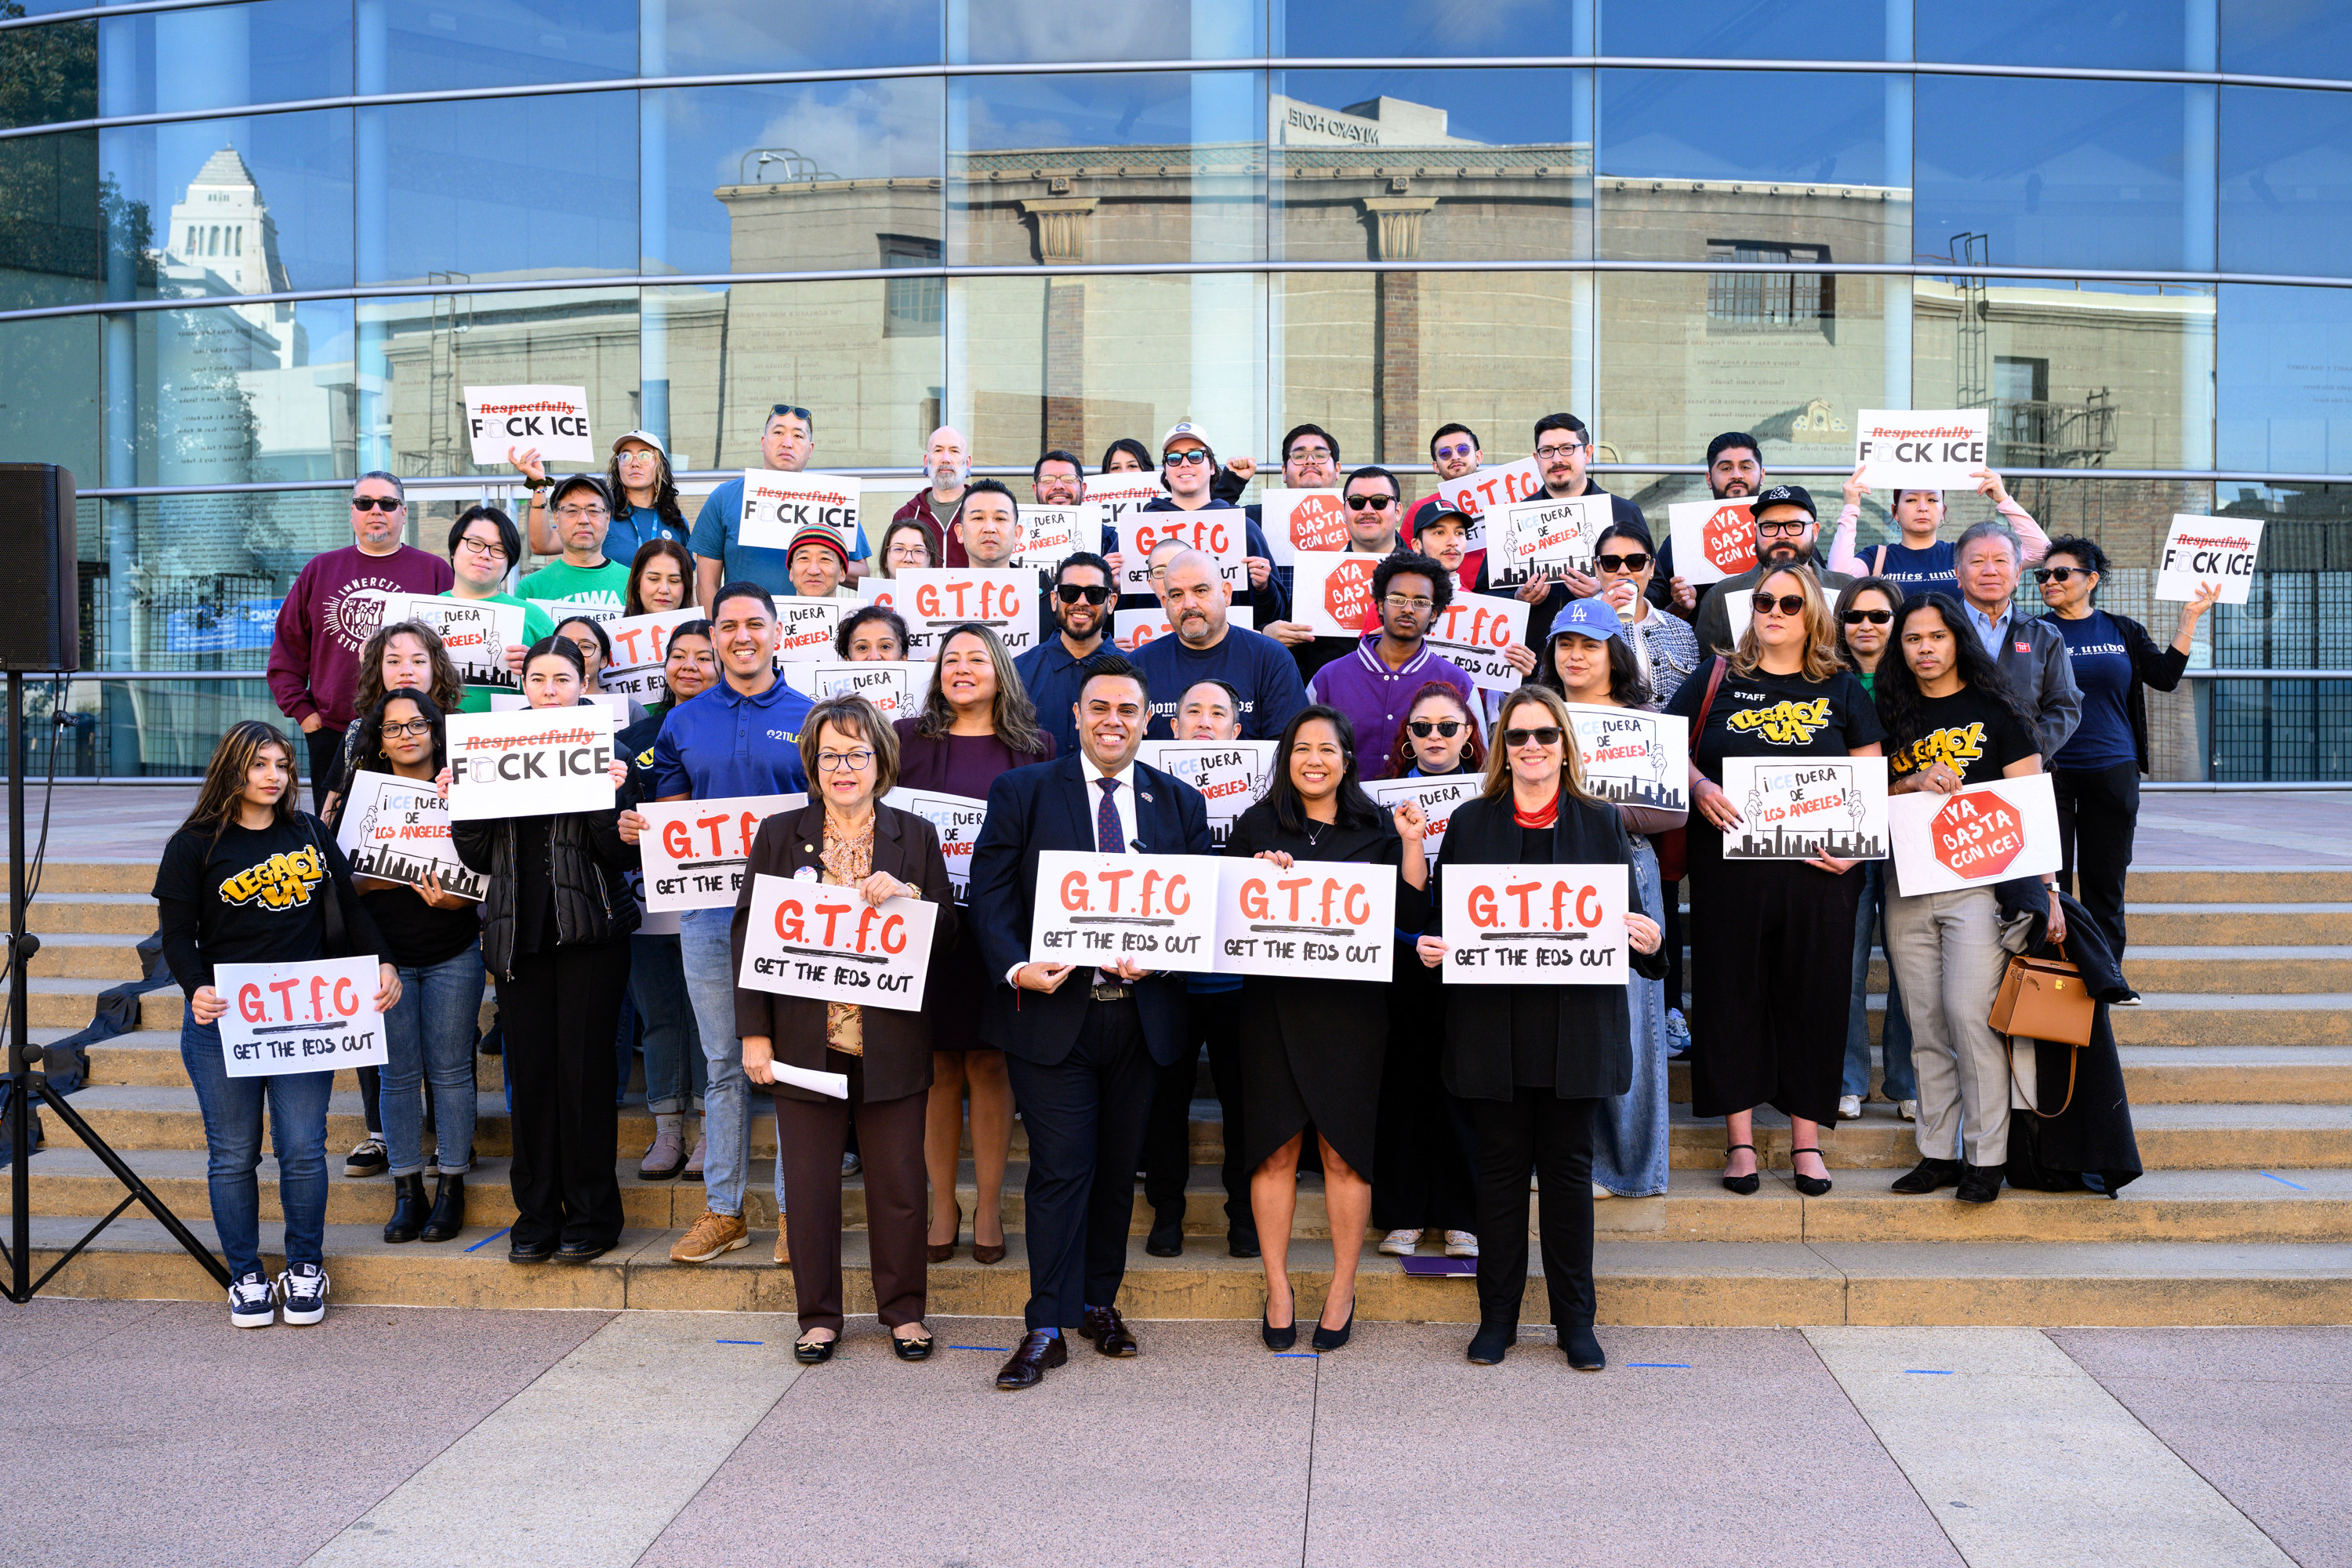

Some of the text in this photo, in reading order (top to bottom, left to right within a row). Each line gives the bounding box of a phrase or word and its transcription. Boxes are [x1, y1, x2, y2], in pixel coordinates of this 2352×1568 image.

[480, 401, 575, 416] Respectfully
[551, 416, 589, 437] ICE
[1871, 426, 1973, 441] Respectfully
[1943, 442, 1984, 463] ICE
[757, 486, 847, 506] Respectfully
[818, 506, 856, 528] ICE
[1298, 498, 1323, 518] ¡YA
[1033, 513, 1065, 528] FUERA
[1296, 510, 1346, 536] BASTA
[1516, 506, 1573, 532] ¡ICE FUERA
[1711, 509, 1740, 532] ¡YA
[1029, 528, 1041, 539] DE
[1029, 528, 1072, 552] ANGELES!
[1298, 527, 1349, 550] CON ICE!
[1519, 521, 1582, 556] LOS ANGELES!
[1538, 525, 1550, 537] DE
[1711, 521, 1753, 551] BAST
[2176, 533, 2251, 551] Respectfully
[1715, 546, 1744, 566] CON
[2225, 554, 2254, 576] ICE
[1336, 563, 1363, 584] ¡YA
[1332, 579, 1373, 604] BAST
[444, 609, 481, 622] FUERA
[789, 606, 826, 622] FUERA
[1334, 602, 1363, 620] CON
[1570, 604, 1587, 622] LA
[438, 625, 451, 636] DE
[784, 624, 797, 637] DE
[784, 625, 833, 650] ANGELES!
[908, 632, 934, 648] GET
[853, 671, 891, 690] FUERA
[1486, 662, 1514, 679] OUT
[615, 678, 641, 694] THE
[647, 675, 666, 691] FED
[1733, 691, 1766, 702] STAFF
[1728, 698, 1830, 731] LEGACY
[1602, 719, 1642, 733] FUERA
[1762, 719, 1813, 745] LA
[465, 728, 596, 751] Respectfully
[1596, 735, 1611, 748] DE
[559, 746, 612, 777] ICE
[1201, 751, 1243, 771] FUERA
[1595, 739, 1650, 764] ANGELES!
[1196, 772, 1210, 787] DE
[1763, 768, 1837, 793] ¡ICE FUERA
[414, 795, 449, 810] FUER
[1419, 786, 1461, 808] FUERA
[1763, 788, 1846, 822] LOS ANGELES!
[1790, 788, 1804, 802] DE
[405, 811, 419, 825] DE
[953, 811, 984, 826] FUER
[1941, 798, 1979, 826] ¡YA
[375, 826, 396, 839] LOS
[944, 828, 959, 841] DE
[1942, 809, 2014, 851] BASTA
[1951, 831, 2022, 869] CON ICE!
[220, 844, 325, 905] LEGACY
[655, 877, 688, 895] GET
[692, 874, 724, 892] THE
[256, 876, 312, 912] LA
[1043, 931, 1202, 955] GET THE FEDS OUT
[1224, 938, 1382, 964] GET THE FEDS OUT
[1454, 946, 1617, 968] GET THE FEDS OUT
[753, 956, 914, 993] GET THE FEDS OUT
[233, 1031, 376, 1062] GET THE FEDS OUT
